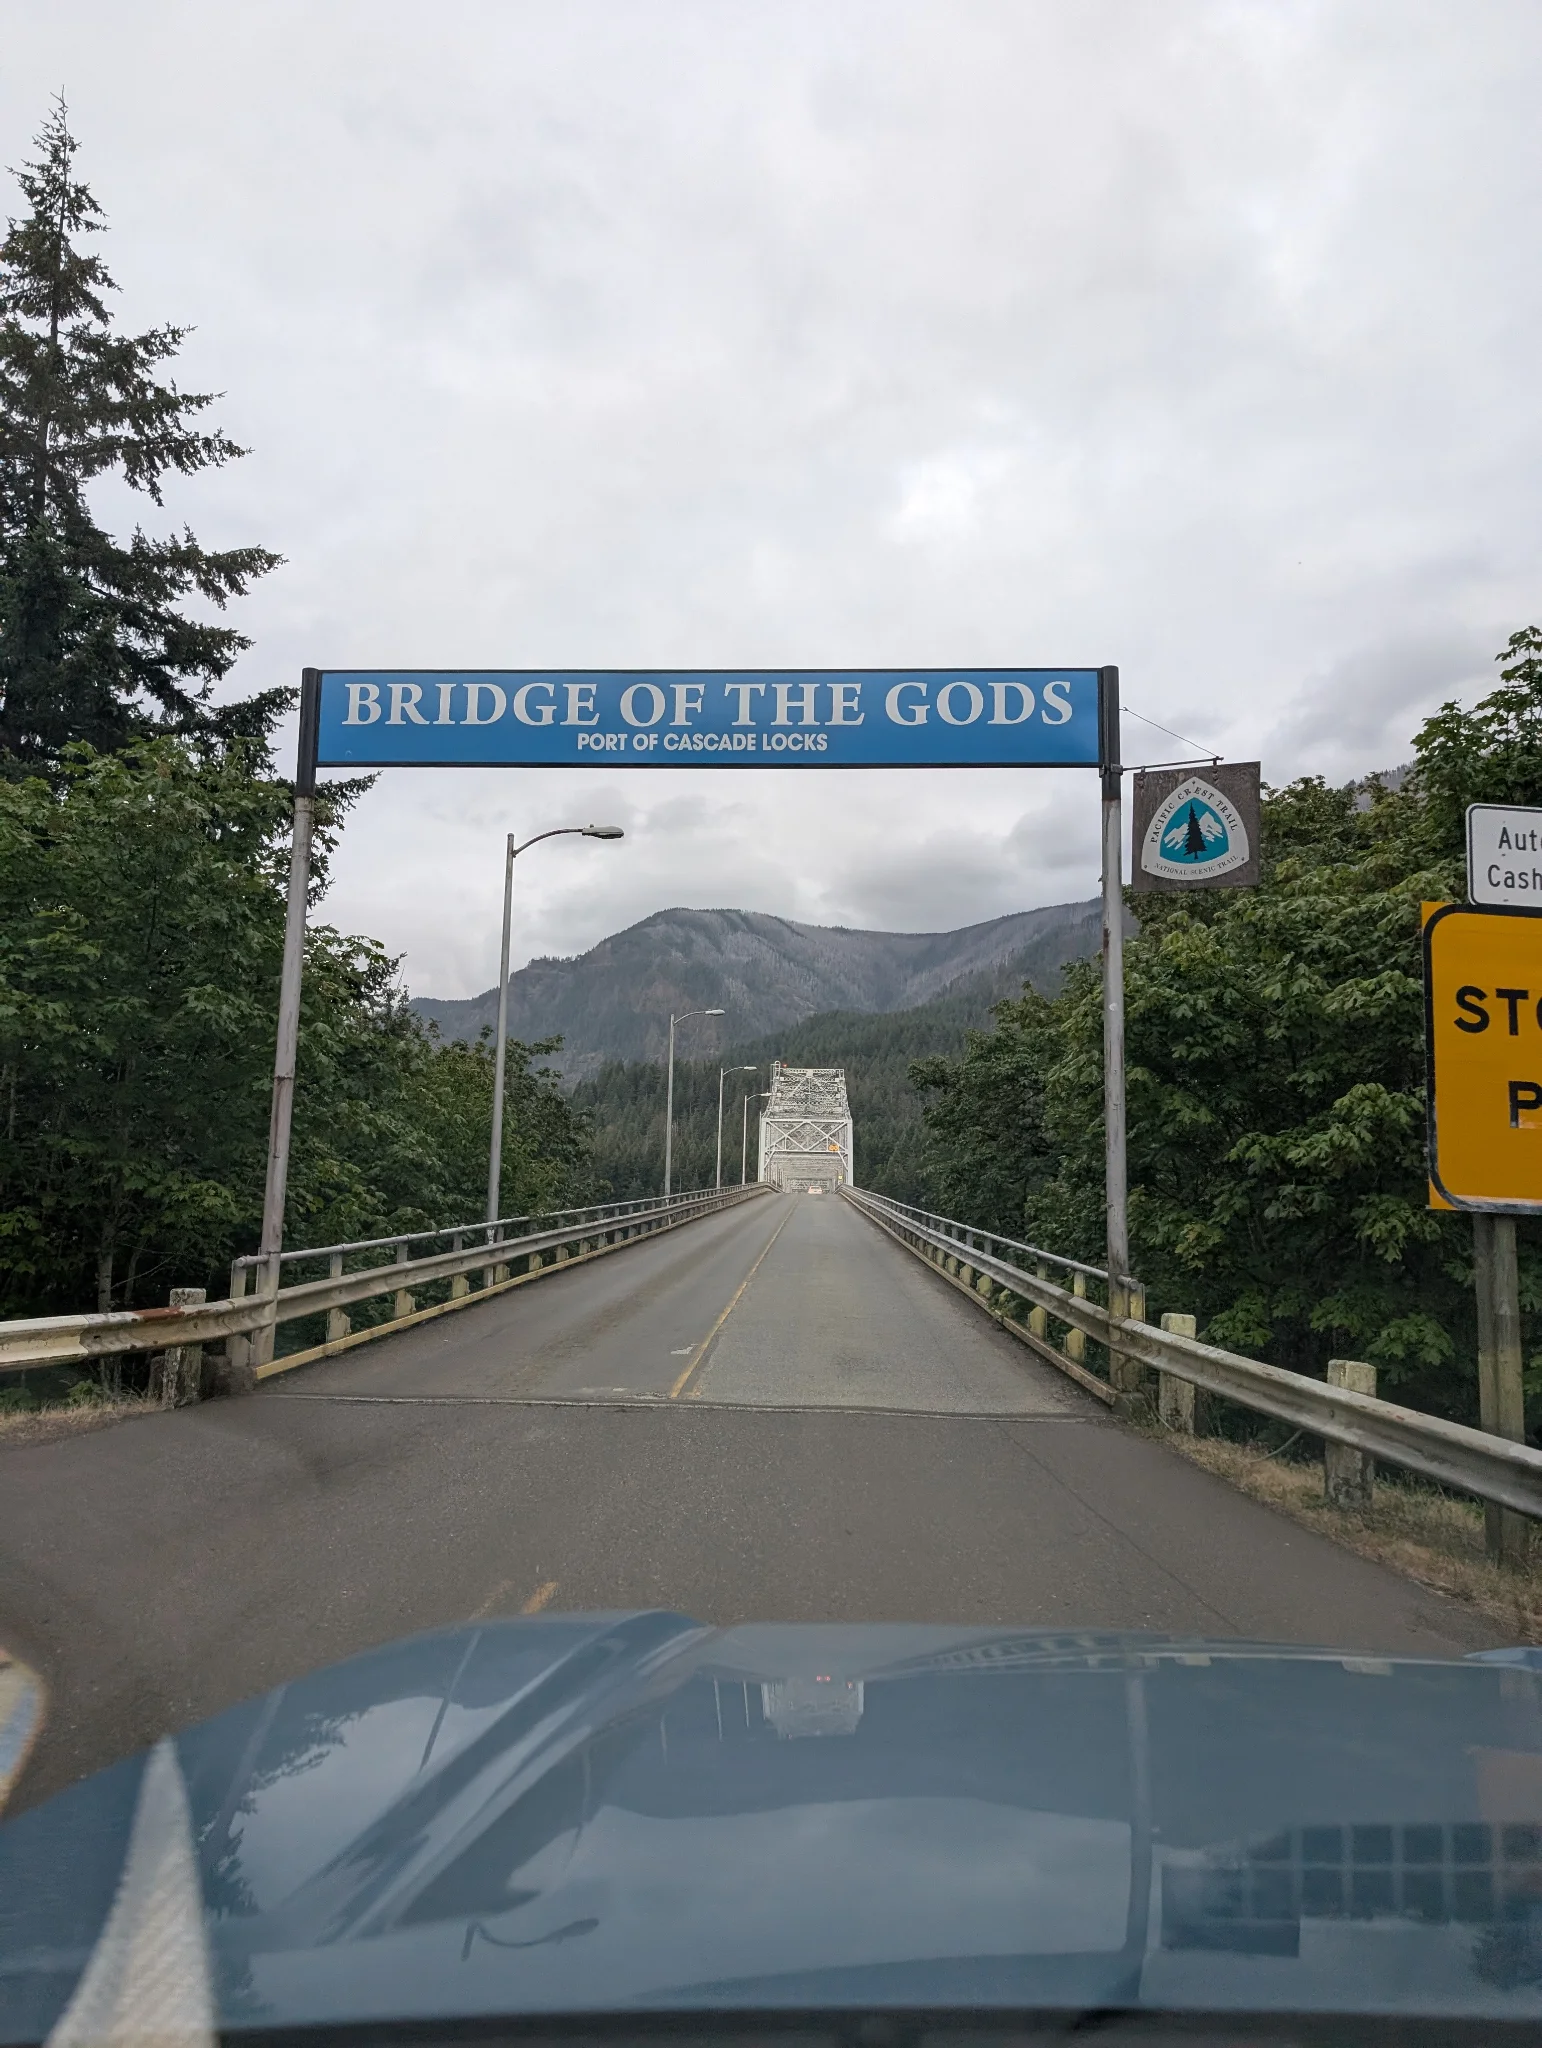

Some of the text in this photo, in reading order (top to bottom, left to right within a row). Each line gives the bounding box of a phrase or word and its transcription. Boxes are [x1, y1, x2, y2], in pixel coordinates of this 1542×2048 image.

[341, 681, 1073, 728] BRIDGE OF THE GODS
[577, 733, 828, 751] PORT OF CASCADE LOCKS
[1150, 786, 1238, 843] PACIFIC CREST TRAIL
[1498, 826, 1542, 851] Aut
[1154, 855, 1239, 876] NATIONAL SCENIC TRAIL
[1488, 864, 1542, 890] Cash
[1453, 985, 1542, 1036] ST
